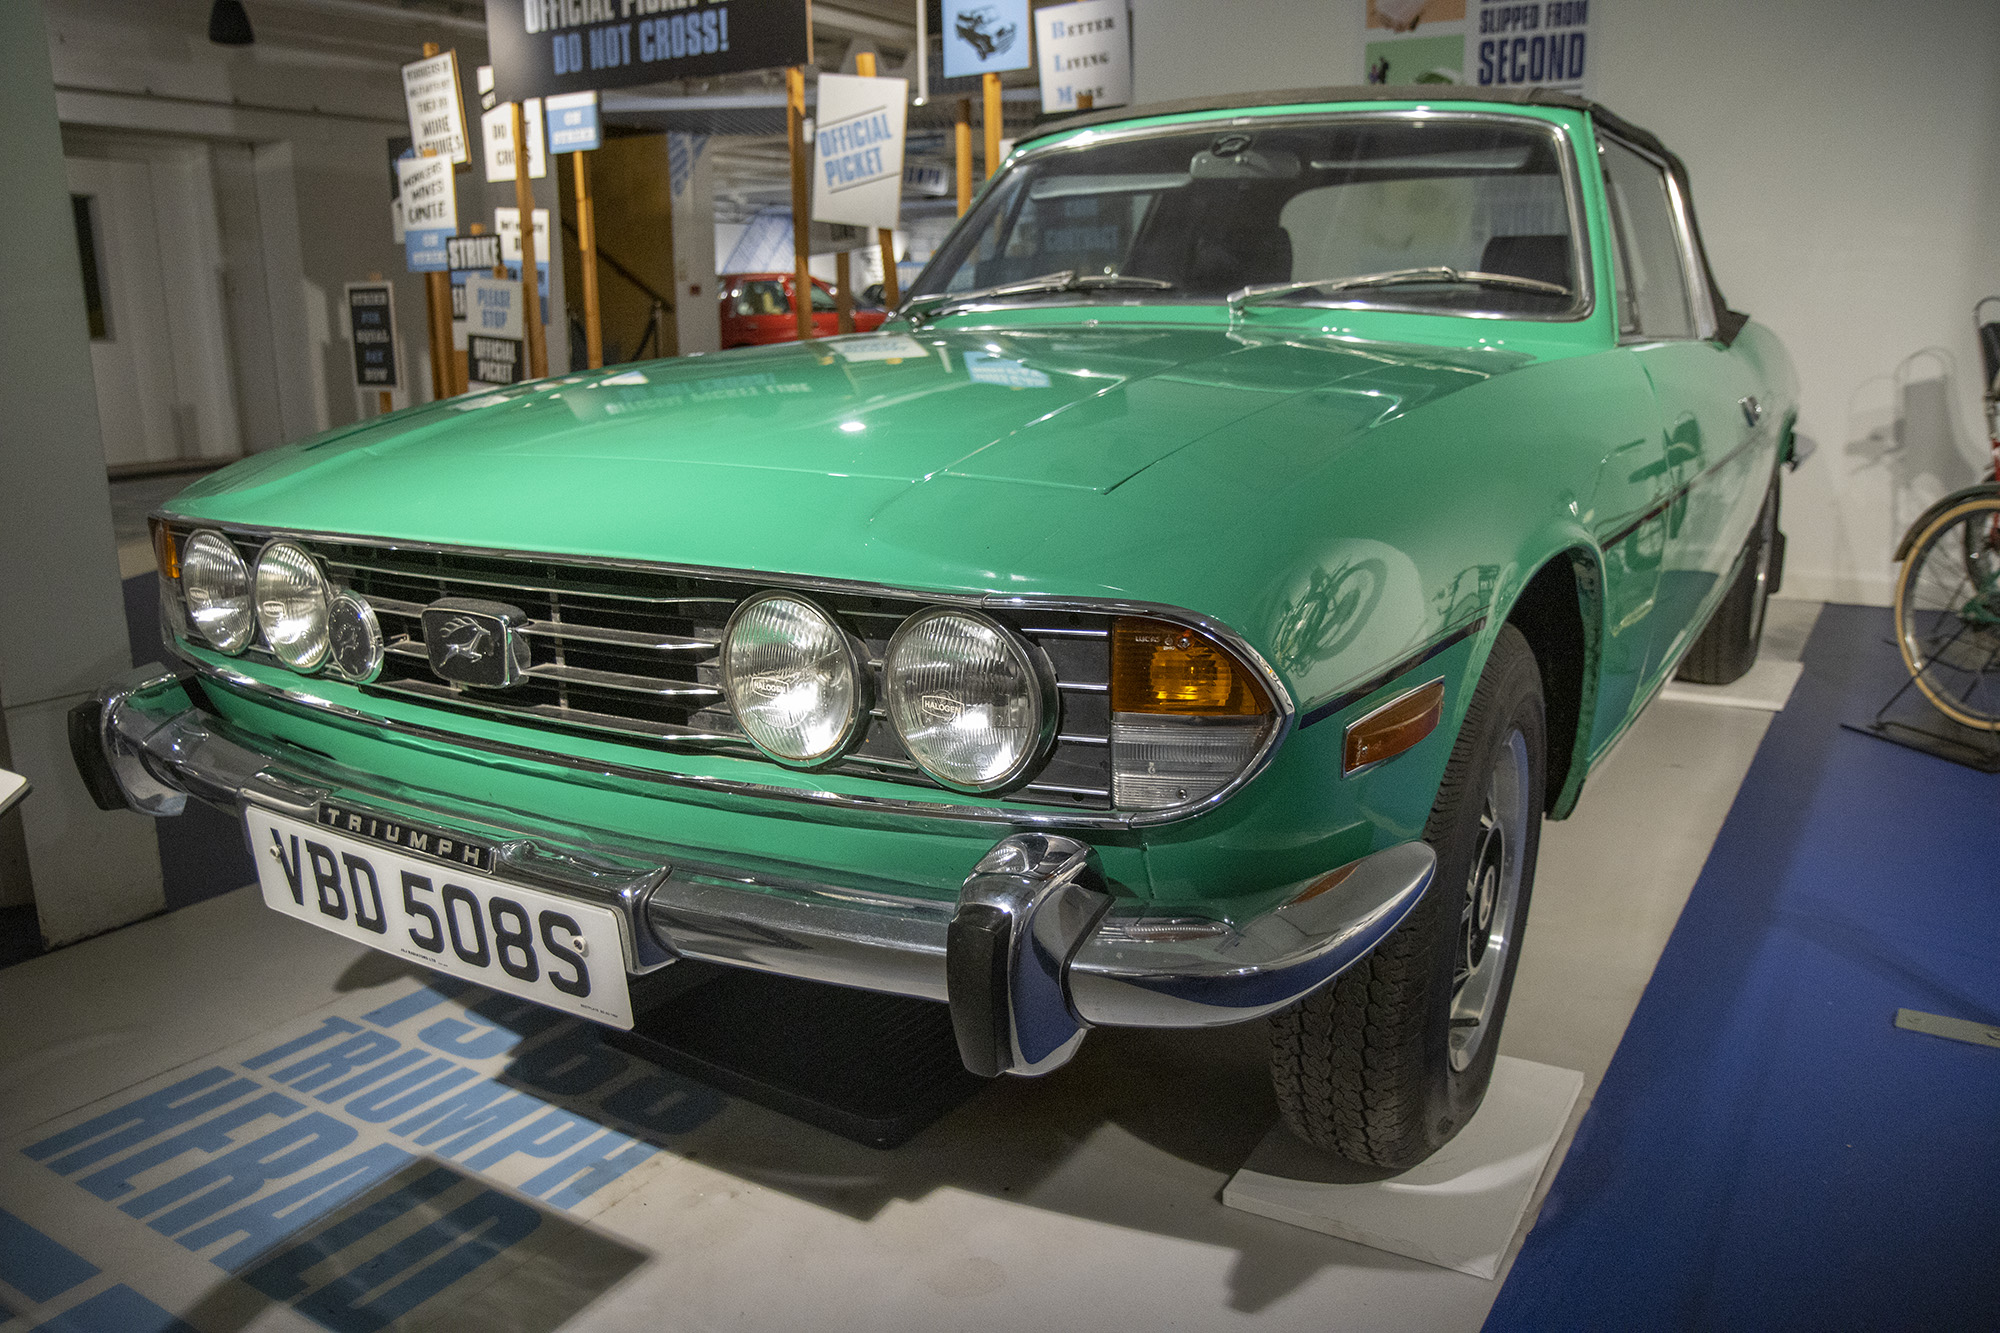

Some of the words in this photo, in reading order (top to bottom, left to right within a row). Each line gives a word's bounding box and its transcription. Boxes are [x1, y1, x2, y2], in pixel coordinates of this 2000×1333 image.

[553, 32, 583, 74] DO
[589, 24, 631, 69] NOT
[639, 8, 729, 62] CROSS!
[1480, 4, 1539, 34] SLIPPED
[1545, 0, 1587, 28] FROM
[1479, 33, 1585, 86] SECOND
[819, 113, 892, 157] OFFICIAL
[825, 146, 882, 186] PICKET
[448, 237, 500, 268] STRIKE
[754, 682, 786, 694] HALOGEN
[924, 701, 962, 714] HALOGEN
[328, 807, 480, 866] TRIUMPH
[270, 827, 388, 935] VBD
[400, 870, 591, 998] 508S
[240, 1015, 668, 1210] TRIUMPH
[20, 1065, 544, 1333] HERALD
